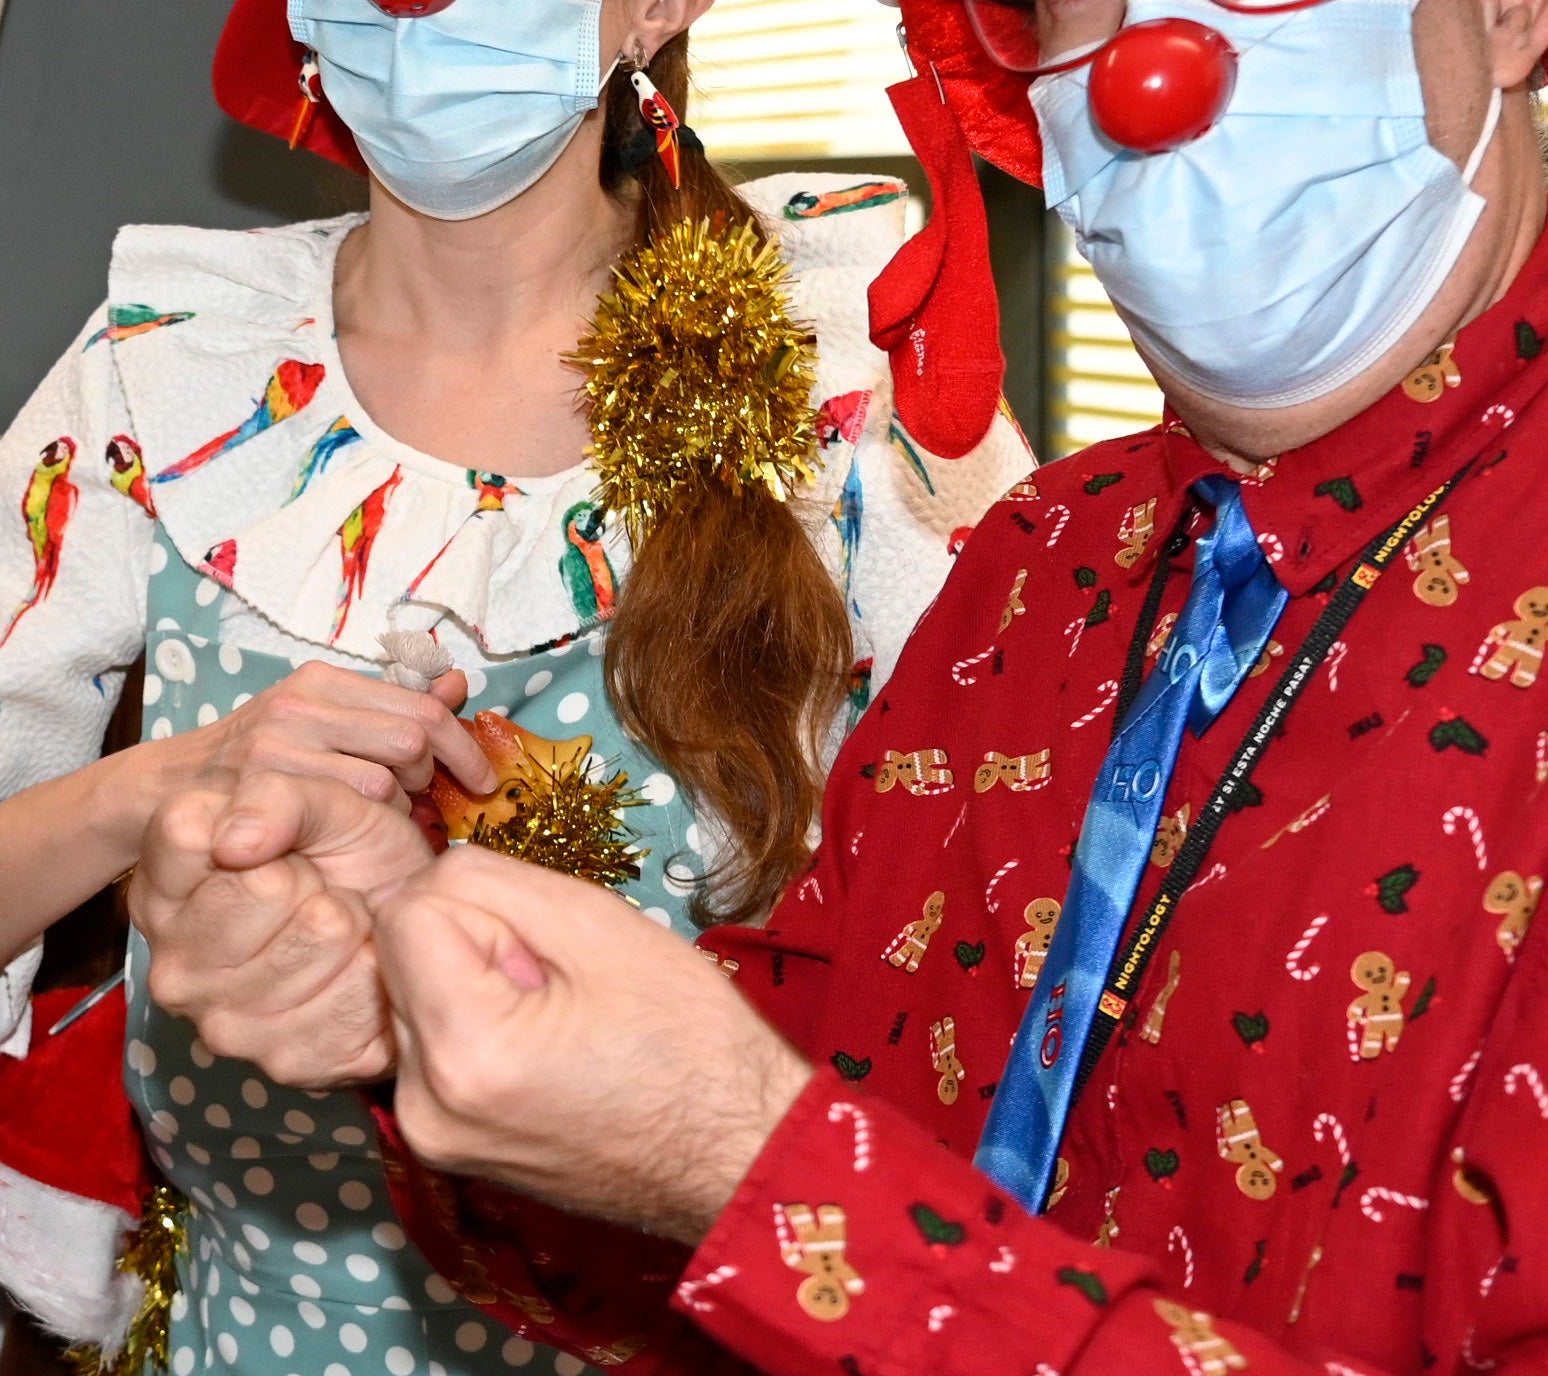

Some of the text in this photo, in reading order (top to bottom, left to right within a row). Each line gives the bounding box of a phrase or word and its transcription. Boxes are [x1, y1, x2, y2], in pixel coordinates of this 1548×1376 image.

[1222, 779, 1236, 795] SI
[1233, 745, 1257, 779] ESTA
[1253, 698, 1287, 744] NOCHE
[1114, 893, 1172, 990] NIGHTOLOGY
[887, 1011, 909, 1046] XMAS
